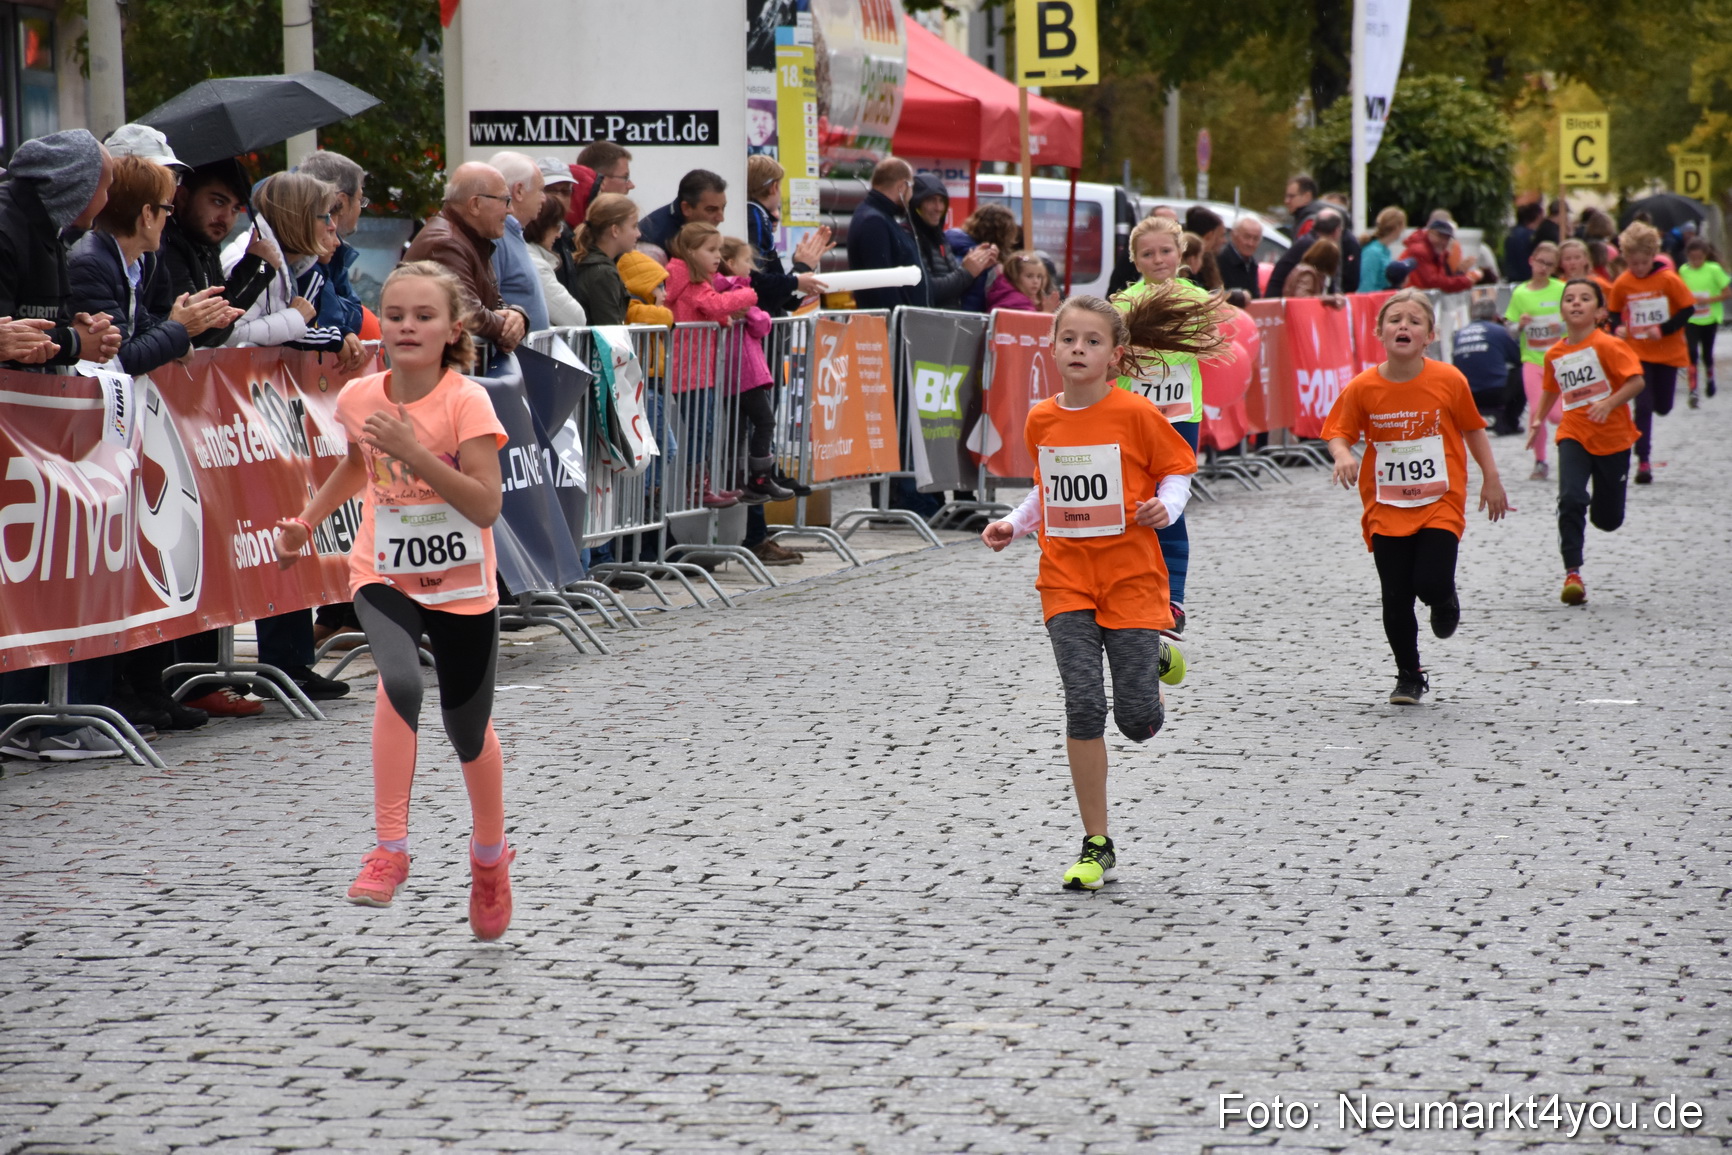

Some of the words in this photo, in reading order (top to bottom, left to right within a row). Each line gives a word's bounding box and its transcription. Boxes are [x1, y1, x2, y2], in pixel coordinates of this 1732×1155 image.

[1037, 1, 1077, 59] B
[780, 64, 803, 88] 18.
[471, 115, 709, 142] www.MINI-Partl.de
[1566, 118, 1602, 130] Block
[1573, 135, 1595, 168] C
[1684, 170, 1701, 193] D
[1635, 311, 1663, 323] 7145
[1561, 366, 1596, 389] 7042
[1141, 383, 1184, 401] 7110
[1369, 411, 1418, 420] Neumarkter
[1061, 455, 1092, 464] BOCK
[1385, 459, 1436, 481] 7193
[1050, 474, 1107, 502] 7000
[1402, 488, 1421, 496] Katja
[1064, 512, 1090, 521] Emma
[389, 531, 467, 567] 7086
[420, 577, 442, 587] Lisa
